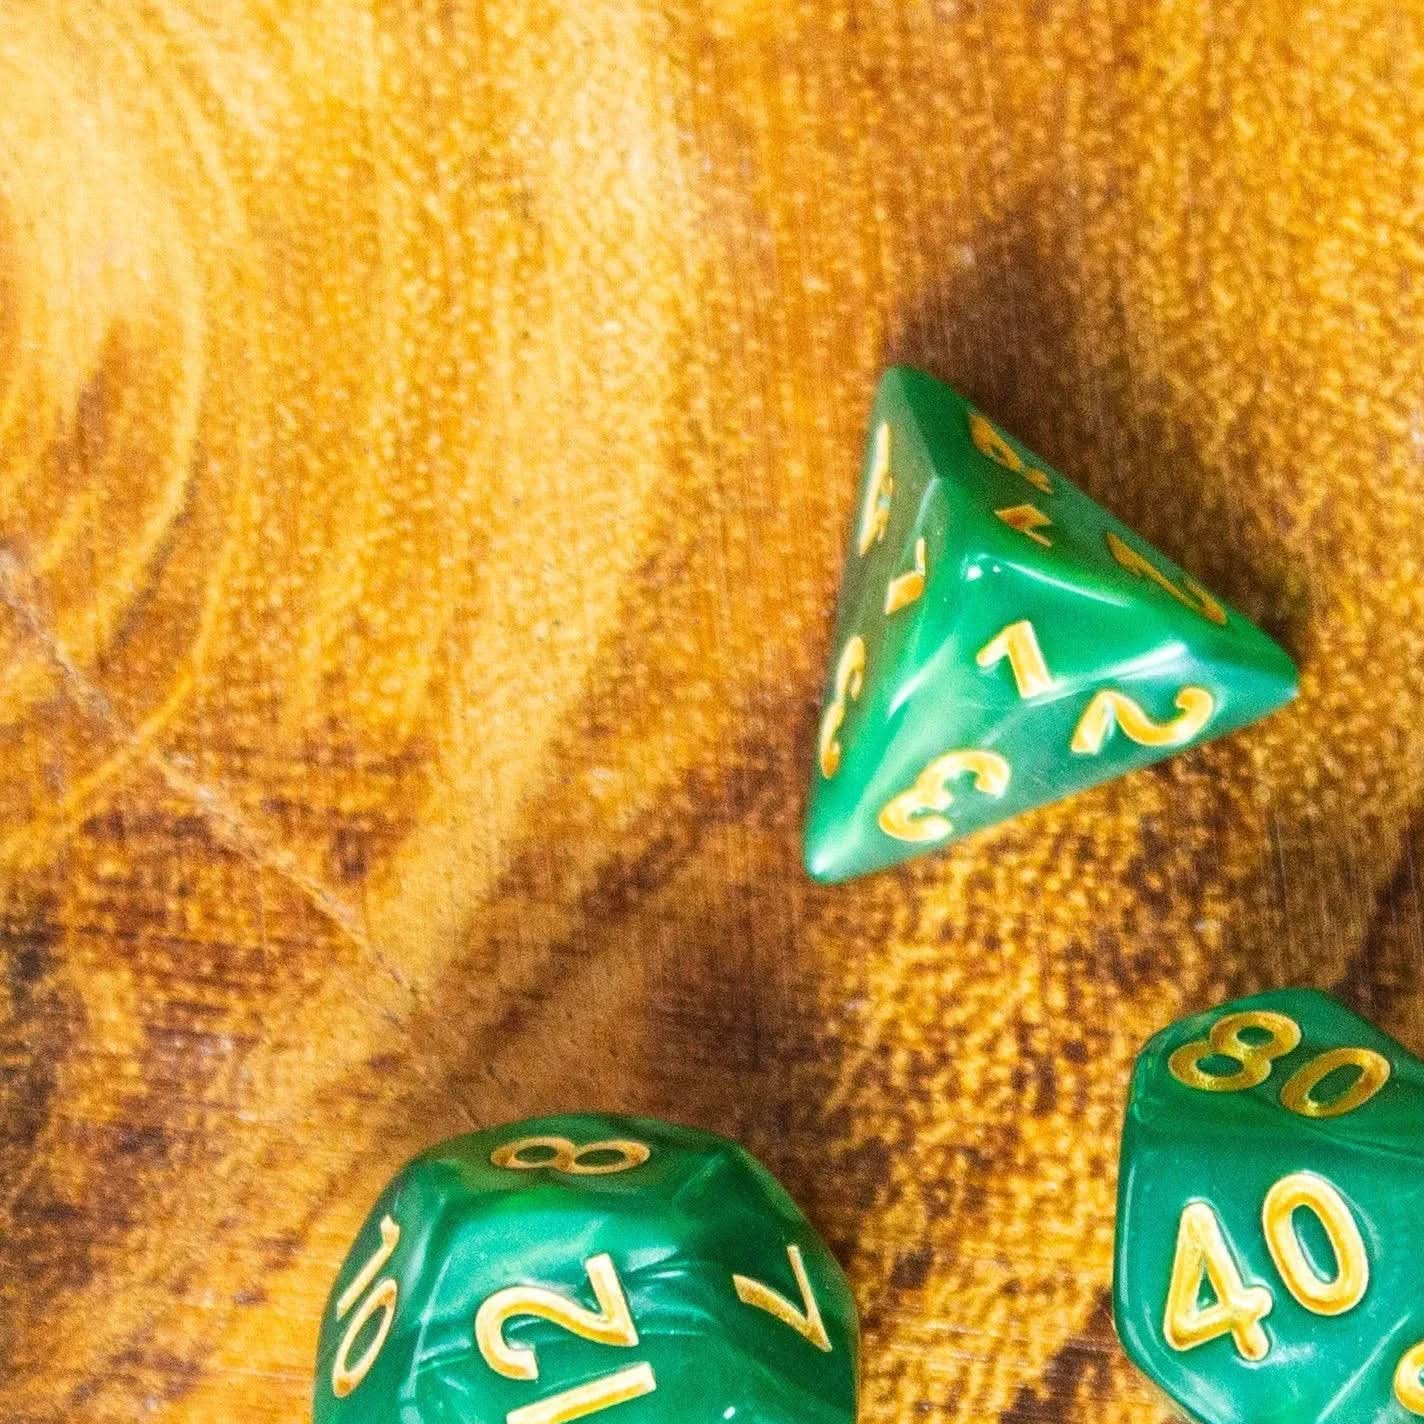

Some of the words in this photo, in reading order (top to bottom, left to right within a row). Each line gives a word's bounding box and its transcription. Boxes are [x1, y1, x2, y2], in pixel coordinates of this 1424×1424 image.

[977, 620, 1056, 699] 1
[1071, 688, 1213, 754] 2
[880, 749, 1010, 842] 3
[1168, 1010, 1391, 1119] 80
[491, 1136, 651, 1175] 8
[332, 1215, 400, 1399] 10
[732, 1245, 833, 1352] 7
[1162, 1170, 1370, 1362] 40
